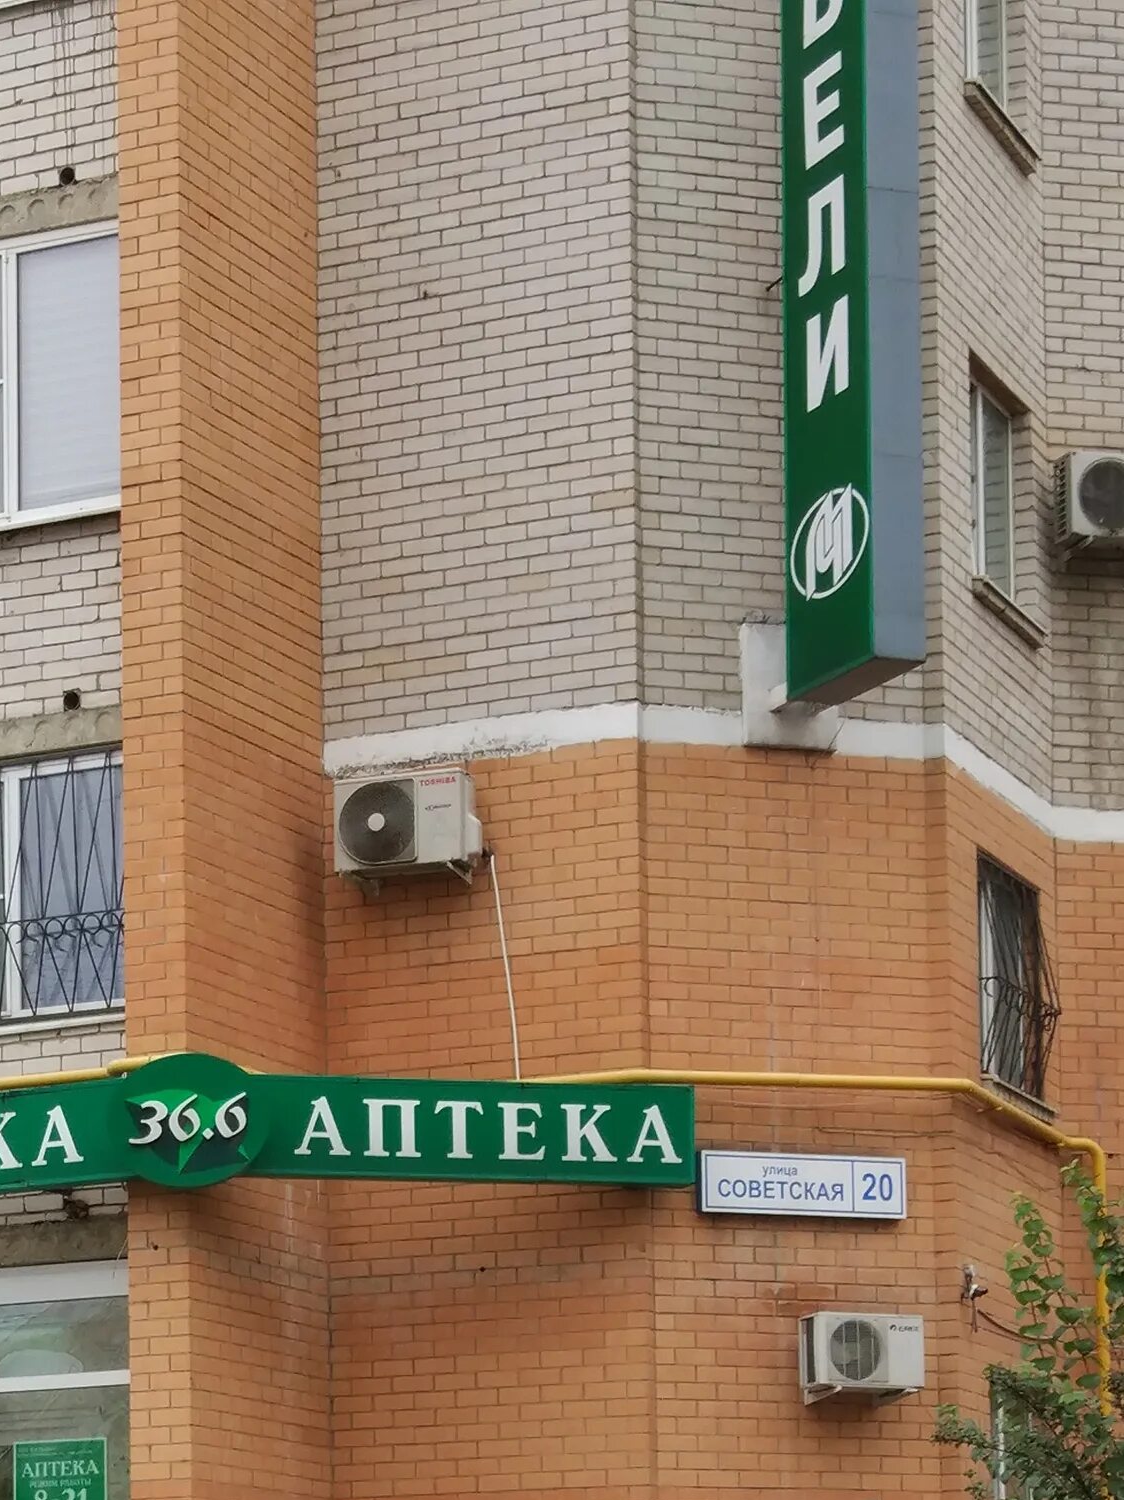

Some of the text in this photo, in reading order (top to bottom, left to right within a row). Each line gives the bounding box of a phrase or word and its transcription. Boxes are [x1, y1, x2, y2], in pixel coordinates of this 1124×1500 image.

[420, 776, 456, 786] TOSHIBA
[128, 1091, 247, 1145] 36.6
[294, 1096, 683, 1164] АПТЕКА
[762, 1165, 798, 1178] улица
[718, 1173, 893, 1201] СОВЕТСКАЯ 20
[22, 1459, 100, 1478] АПТЕКА
